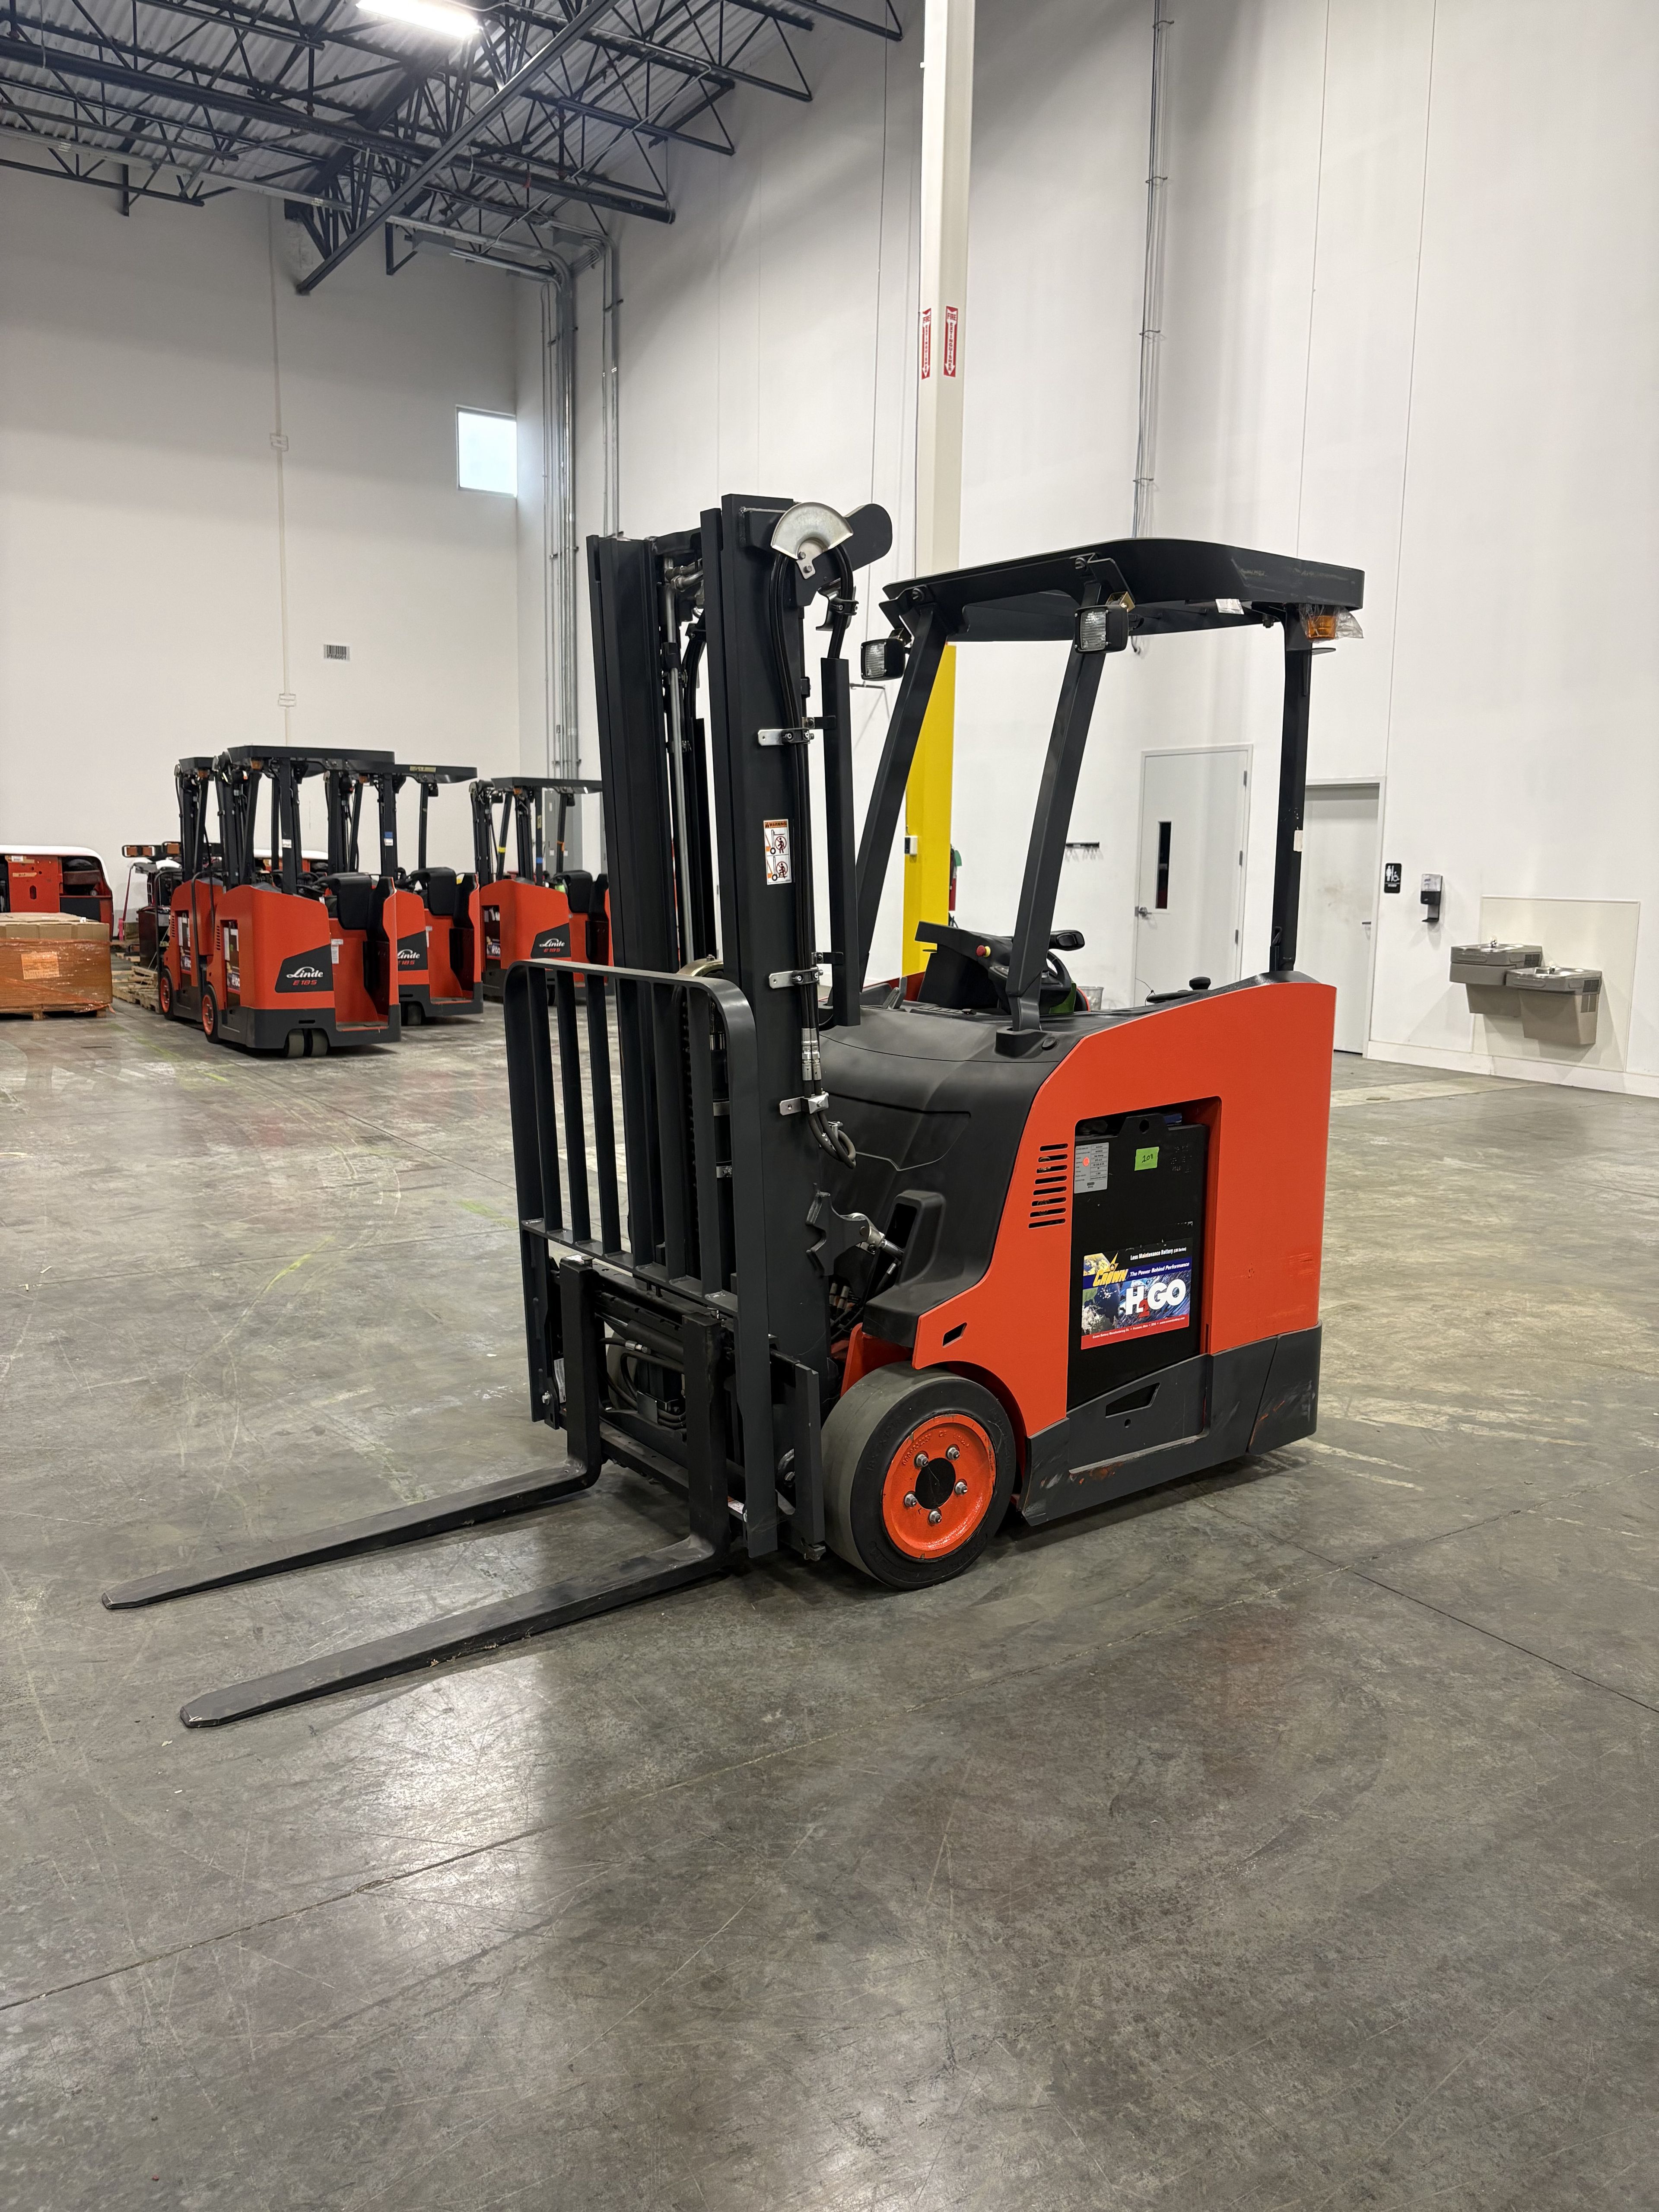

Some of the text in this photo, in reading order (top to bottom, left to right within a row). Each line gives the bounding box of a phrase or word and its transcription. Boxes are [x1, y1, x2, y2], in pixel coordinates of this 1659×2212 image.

[947, 312, 957, 321] FIRE
[539, 938, 565, 947] Linde
[286, 966, 323, 978] Linde
[1139, 1251, 1160, 1259] Maintenance
[1165, 1262, 1190, 1271] Performance
[1093, 1269, 1128, 1287] CROWN
